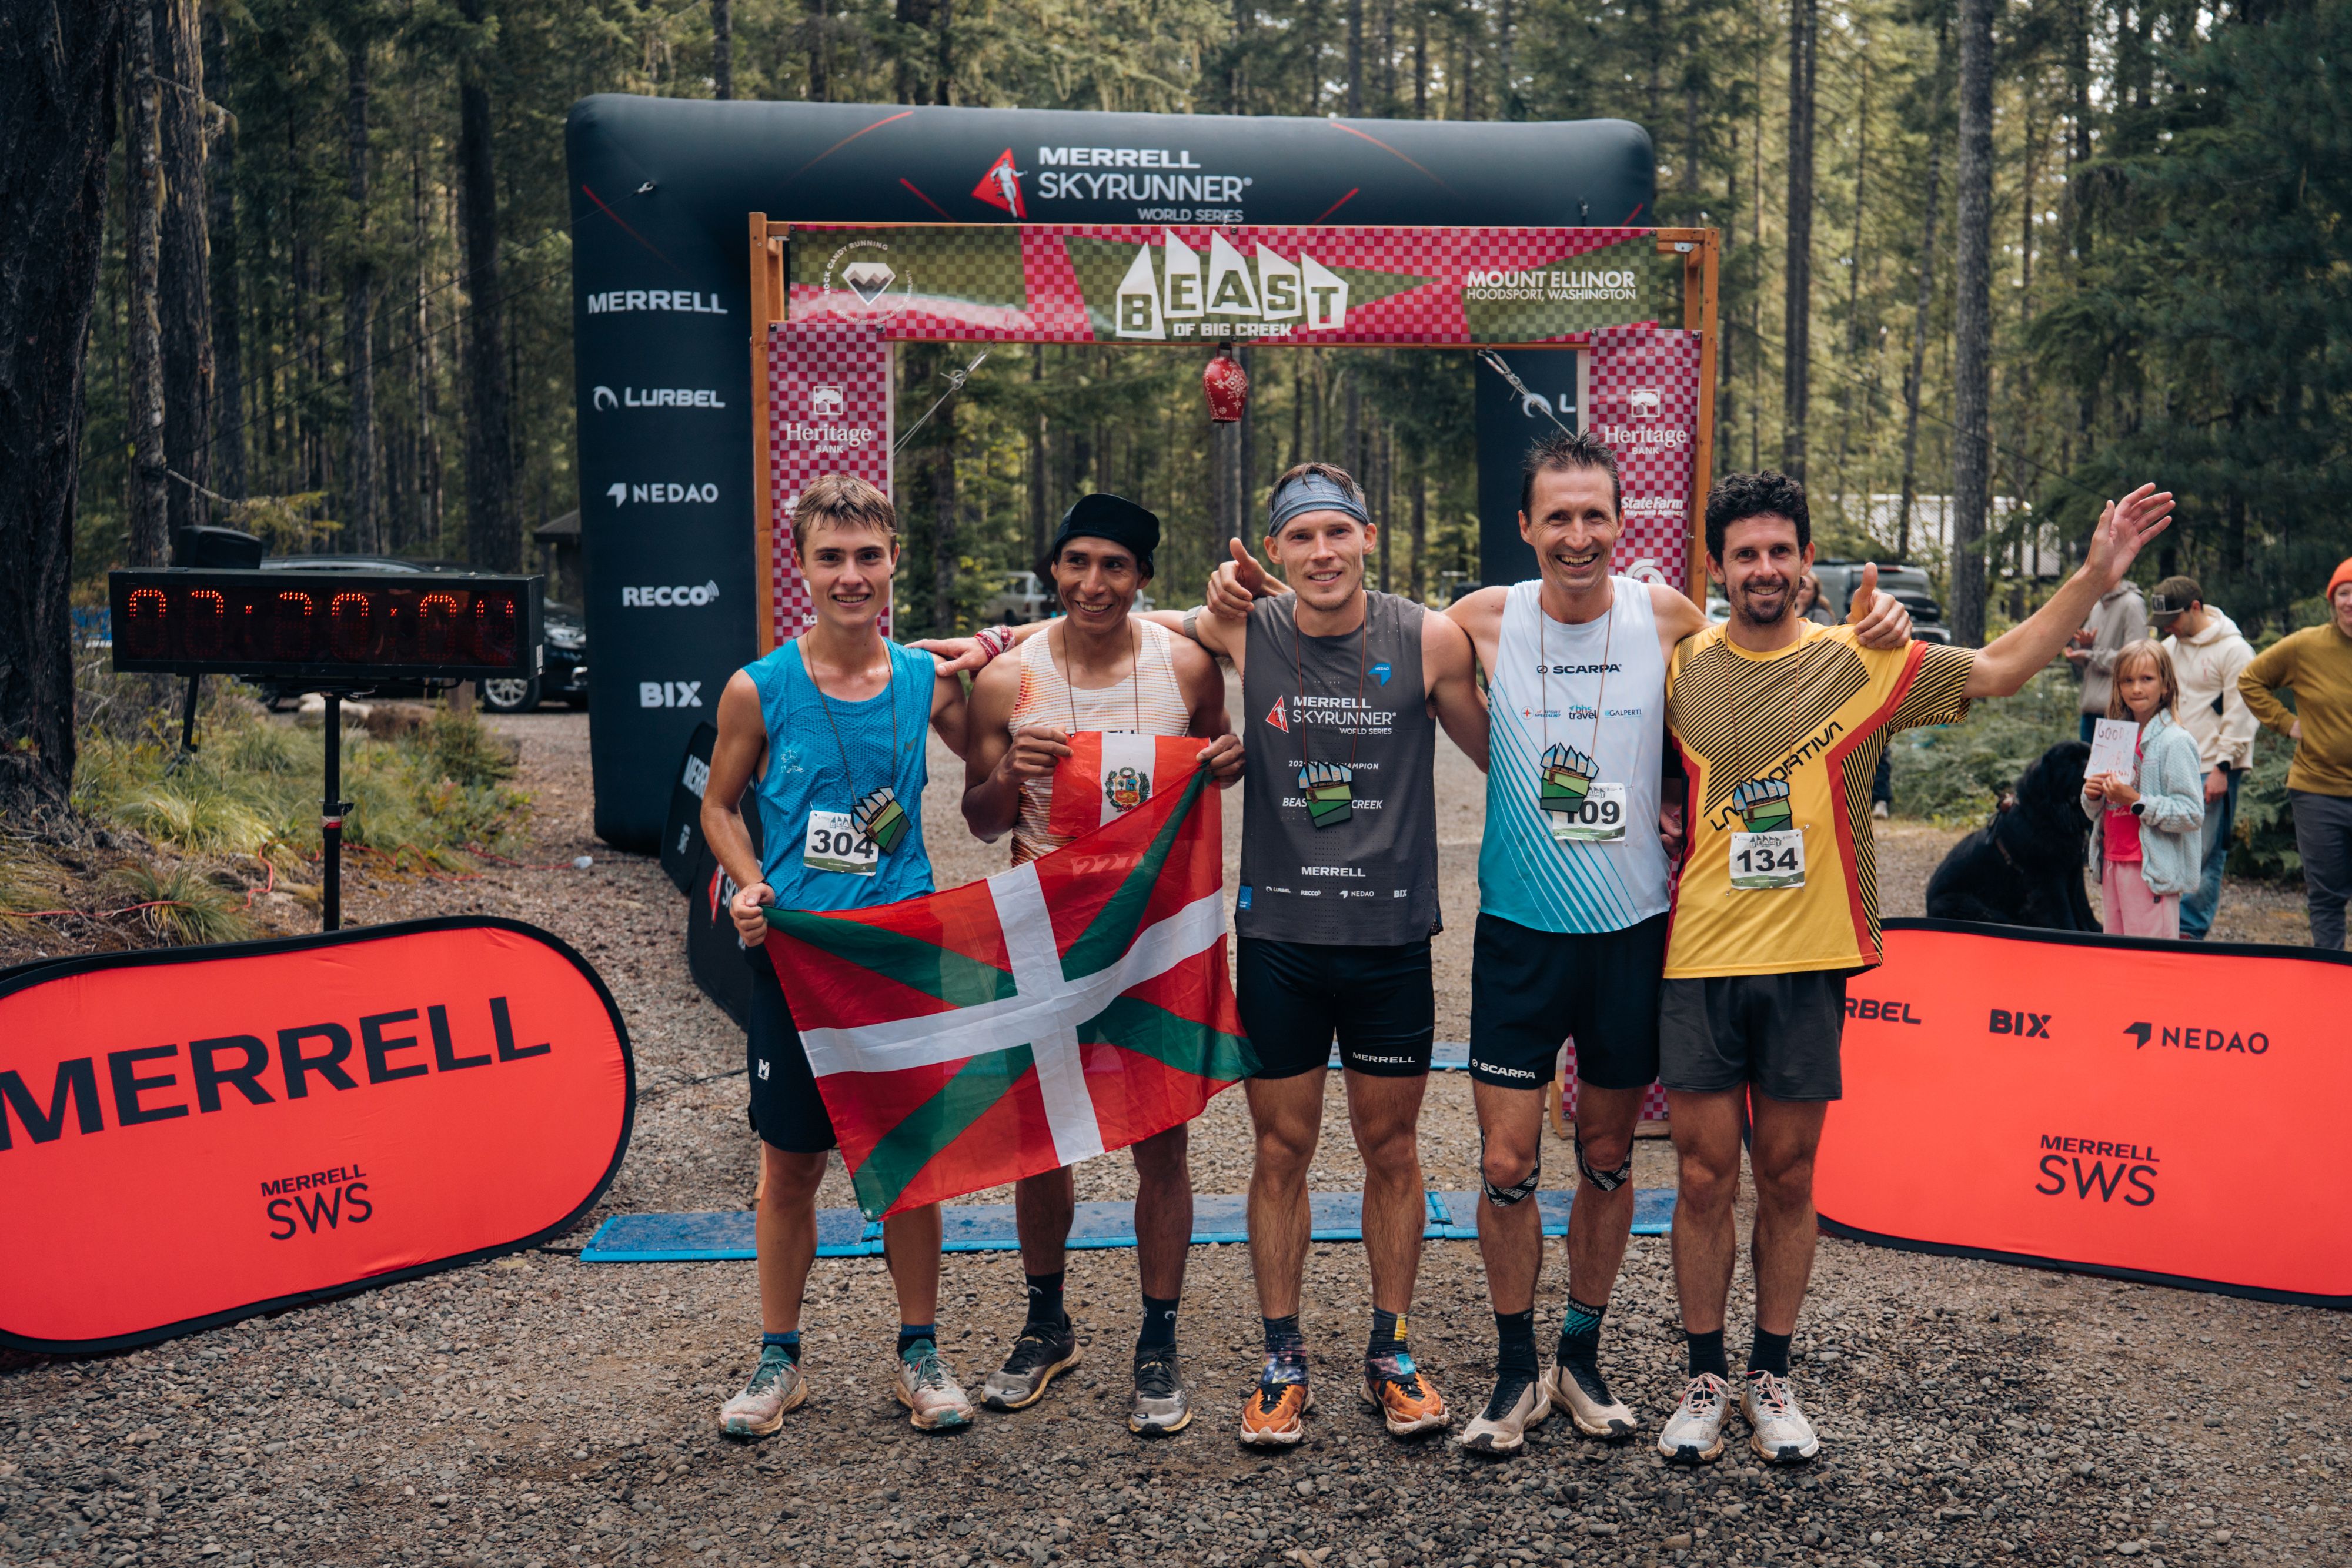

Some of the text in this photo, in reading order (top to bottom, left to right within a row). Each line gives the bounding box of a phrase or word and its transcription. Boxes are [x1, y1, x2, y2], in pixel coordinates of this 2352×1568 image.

[1038, 146, 1201, 169] MERRELL
[1137, 208, 1244, 222] WORLD SERIES
[824, 240, 889, 295] ROCK CANDY RUNNING
[1116, 235, 1349, 339] BEAST
[1467, 271, 1636, 287] MOUNT ELLINOR
[588, 290, 729, 314] MERRELL
[1466, 289, 1636, 302] HOODSPORT, WASHINGTON
[1173, 323, 1293, 337] OF BIG CREEK
[624, 386, 726, 408] LURBEL
[786, 423, 873, 447] Heritage
[1604, 426, 1687, 448] Heritage
[815, 445, 844, 454] BANK
[1632, 447, 1659, 455] BANK
[632, 482, 719, 503] NEDAO
[1657, 509, 1684, 517] Agency
[623, 586, 710, 607] RECCO
[1553, 664, 1621, 674] SCARPA
[640, 681, 703, 708] BIX
[1294, 696, 1371, 708] MERRELL
[1569, 710, 1597, 720] travel
[1575, 705, 1592, 713] bhs
[2097, 720, 2125, 740] GOOD
[1768, 721, 1844, 781] ORTIVA
[1587, 786, 1606, 798] AST
[1282, 798, 1384, 810] BEAS CREEK
[830, 816, 855, 829] BEA
[811, 828, 874, 859] 304
[1750, 835, 1782, 847] BEAST
[1736, 847, 1798, 872] 134
[1301, 866, 1366, 877] MERRELL
[1394, 889, 1407, 898] BIX
[1989, 1008, 2052, 1039] BIX
[2162, 1026, 2269, 1055] NEDAO
[1353, 1052, 1416, 1064] MERRELL
[0, 996, 552, 1152] MERRELL
[1480, 1062, 1536, 1079] SCARPA
[2041, 1134, 2160, 1162] MERRELL
[260, 1164, 367, 1197] MERRELL
[2035, 1154, 2158, 1207] SWS
[267, 1182, 373, 1241] SWS
[1568, 1300, 1599, 1316] ARPA
